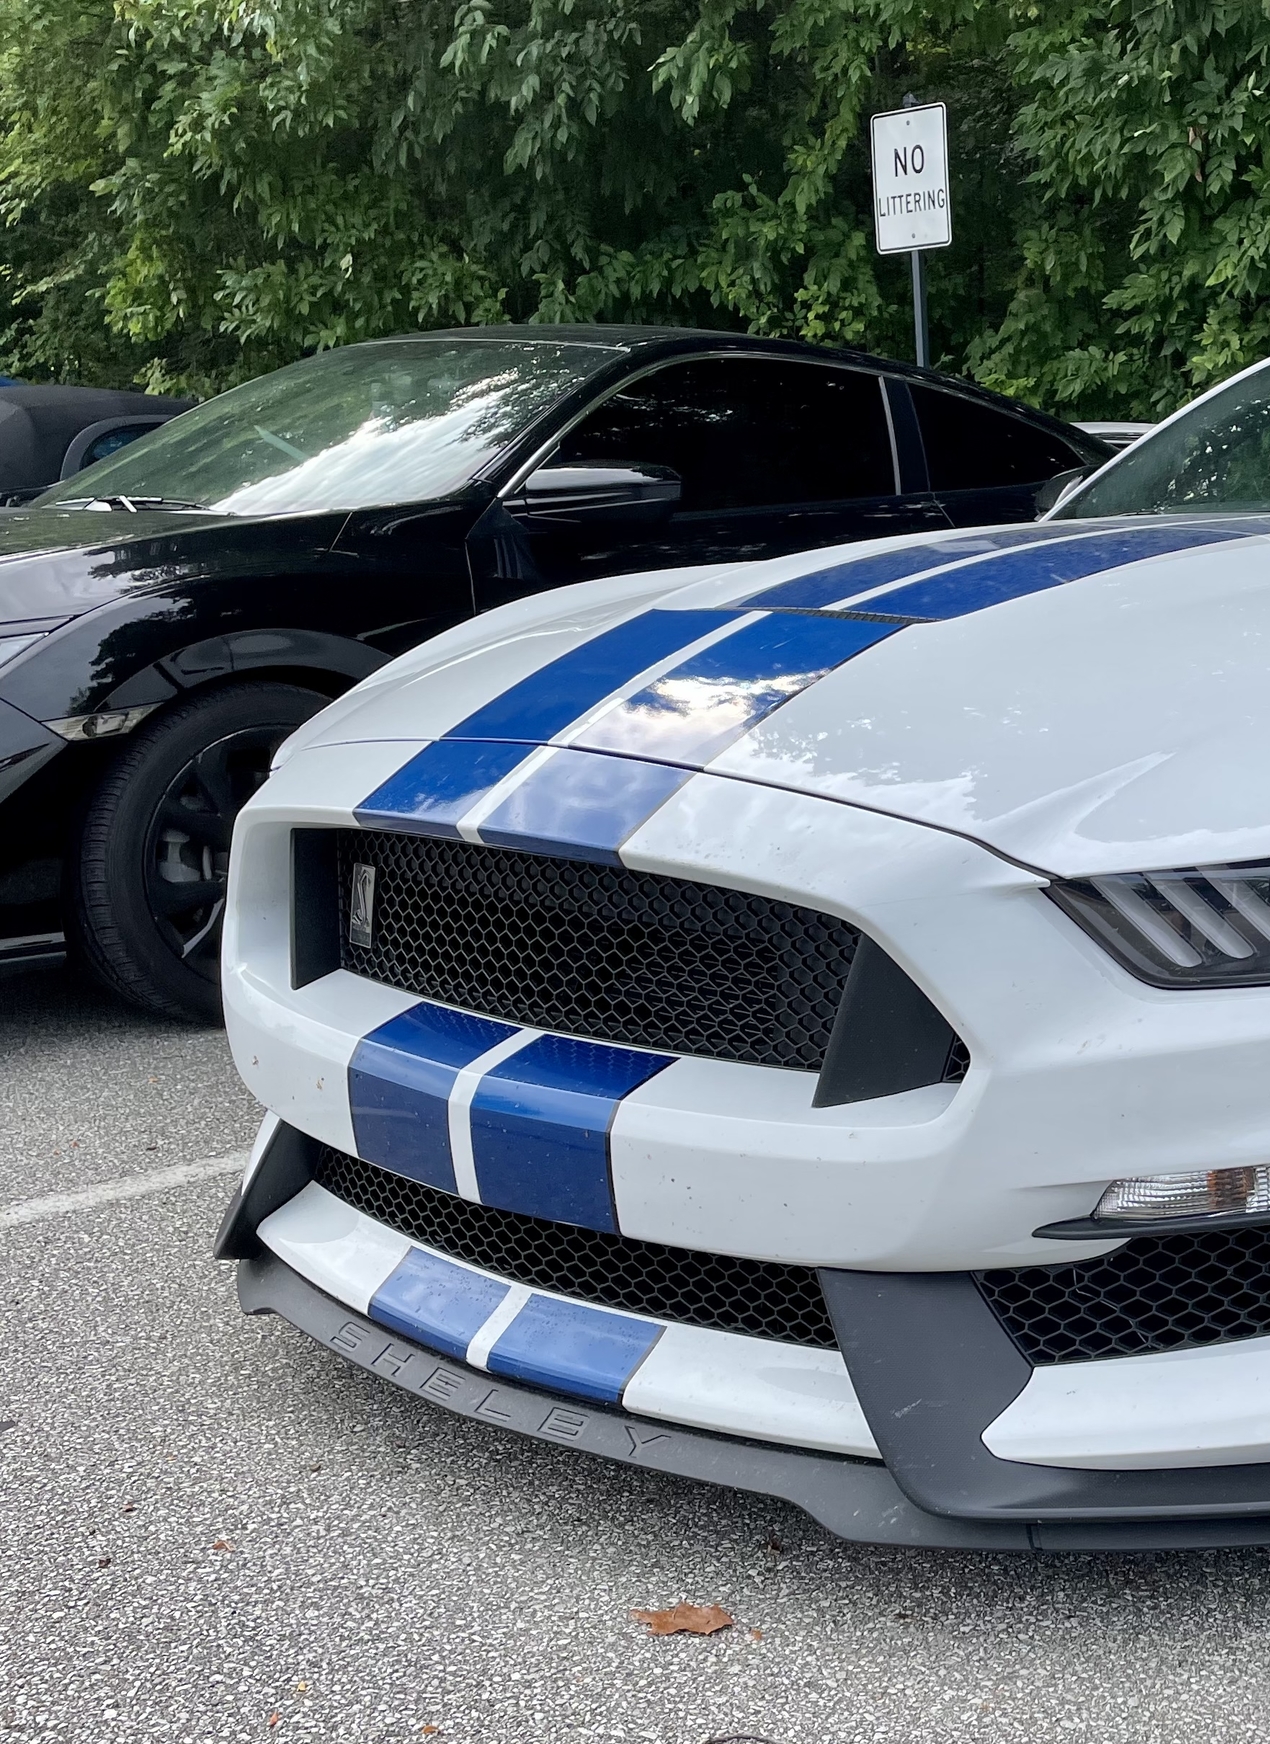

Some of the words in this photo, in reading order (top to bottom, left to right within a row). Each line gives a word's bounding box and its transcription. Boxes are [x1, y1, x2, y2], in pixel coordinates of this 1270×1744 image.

[894, 145, 925, 177] NO
[878, 188, 946, 218] LITTERING
[329, 1321, 672, 1459] SHELBY
